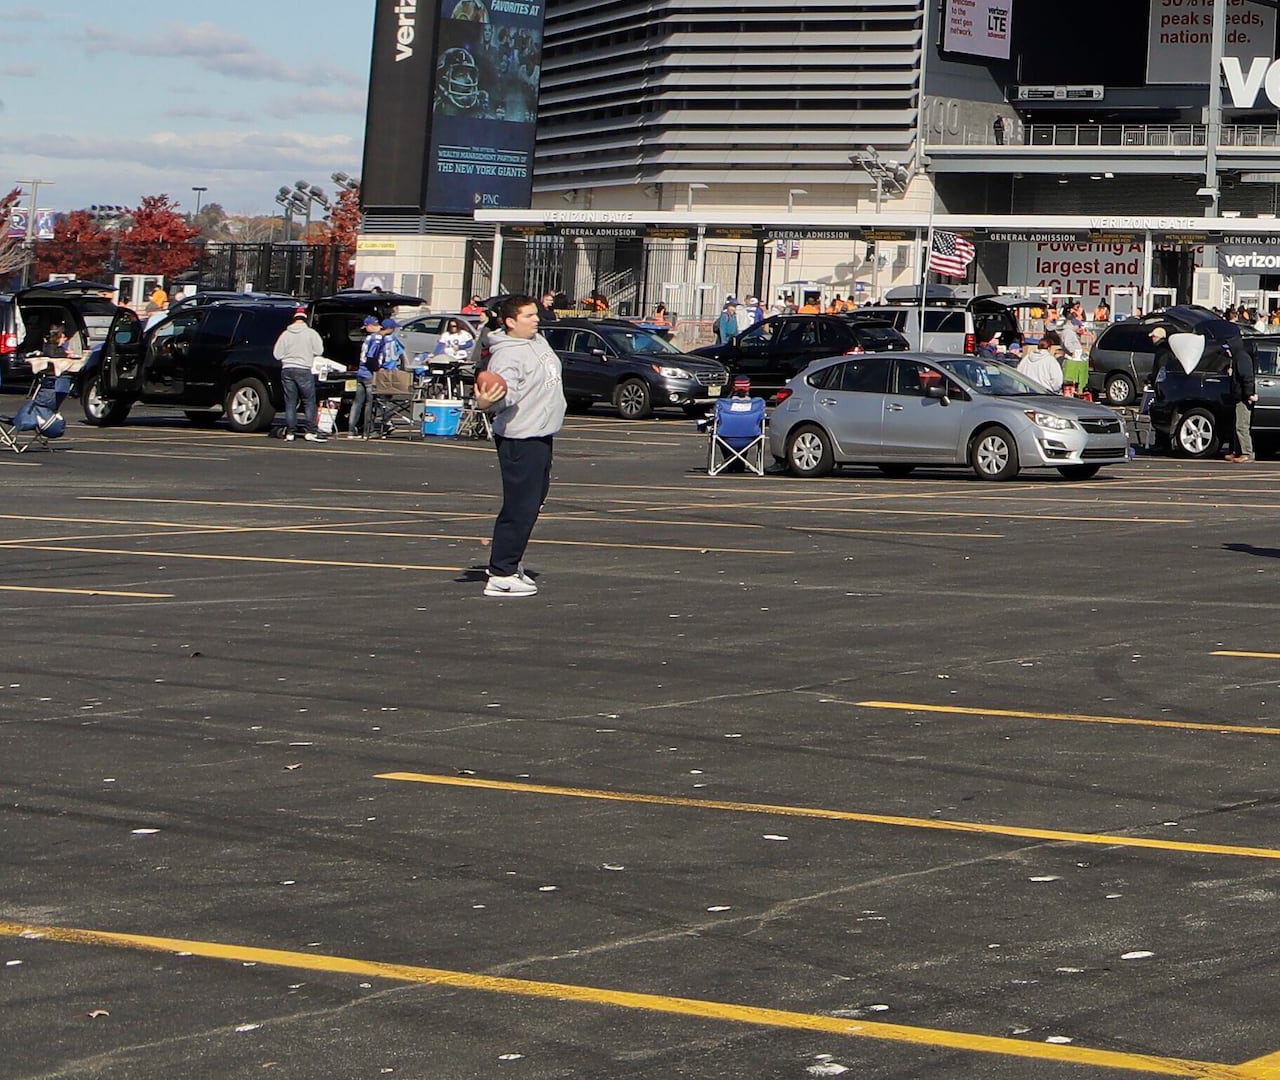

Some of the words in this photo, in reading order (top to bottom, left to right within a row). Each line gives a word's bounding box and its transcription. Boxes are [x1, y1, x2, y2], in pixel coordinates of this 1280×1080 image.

[491, 0, 529, 15] FAVORITES
[529, 6, 540, 16] AT
[988, 15, 1006, 32] LTE
[1161, 12, 1199, 27] peak
[1203, 11, 1264, 28] seeds,
[1160, 30, 1251, 44] nationide.
[438, 162, 453, 172] THE
[455, 164, 474, 174] NEW
[476, 165, 496, 175] YORK
[498, 167, 527, 177] GIANTS
[482, 194, 499, 204] PNC
[544, 212, 594, 222] VERIZON
[602, 213, 633, 222] GATE
[1090, 218, 1151, 229] VERIZON
[1158, 219, 1196, 229] GATE
[561, 228, 593, 236] GENERAL
[806, 231, 849, 239] ADMISSION
[990, 233, 1027, 241] GENERAL
[1030, 234, 1075, 242] ADMISSION
[1224, 236, 1262, 244] GENERAL
[1036, 257, 1100, 277] largest
[1104, 259, 1138, 274] and
[1067, 280, 1100, 296] LTE
